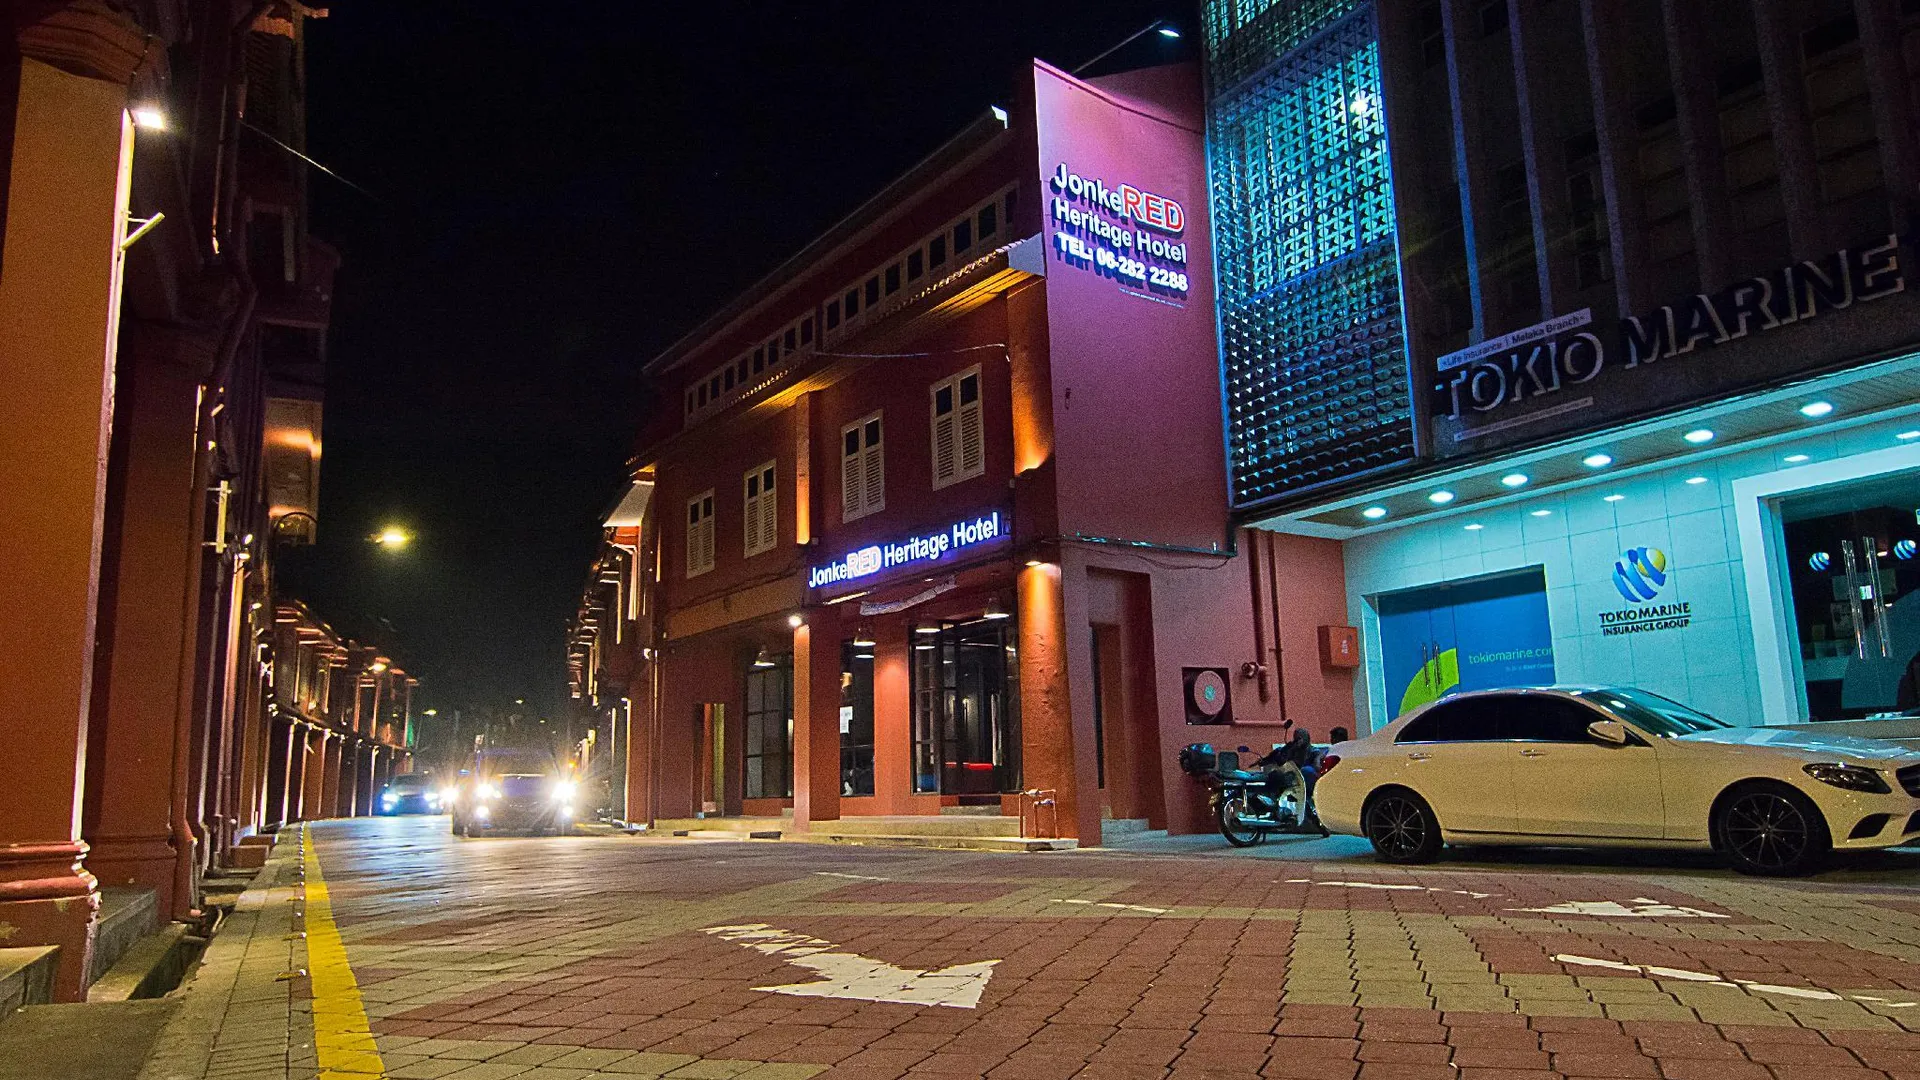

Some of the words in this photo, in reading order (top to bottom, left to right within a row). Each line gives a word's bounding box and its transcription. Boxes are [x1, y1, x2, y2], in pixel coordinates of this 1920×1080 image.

[1053, 162, 1185, 233] JonkeRED
[1054, 197, 1132, 248] Heritage
[1136, 230, 1188, 264] Hotel
[1055, 231, 1094, 261] TEL:
[1096, 248, 1147, 281] 06-282
[1149, 266, 1189, 292] 2288
[1434, 331, 1604, 421] TOKIO
[1621, 233, 1905, 370] MARINE
[1511, 328, 1545, 344] Melaka
[1546, 315, 1580, 333] Branch
[808, 545, 882, 588] JonkeRED
[884, 532, 949, 567] Heritage
[952, 511, 999, 548] Hotel
[1599, 609, 1638, 623] TOKIO
[1638, 602, 1691, 619] MARINE
[1602, 623, 1655, 636] INSURANCE
[1655, 619, 1690, 630] GROUP
